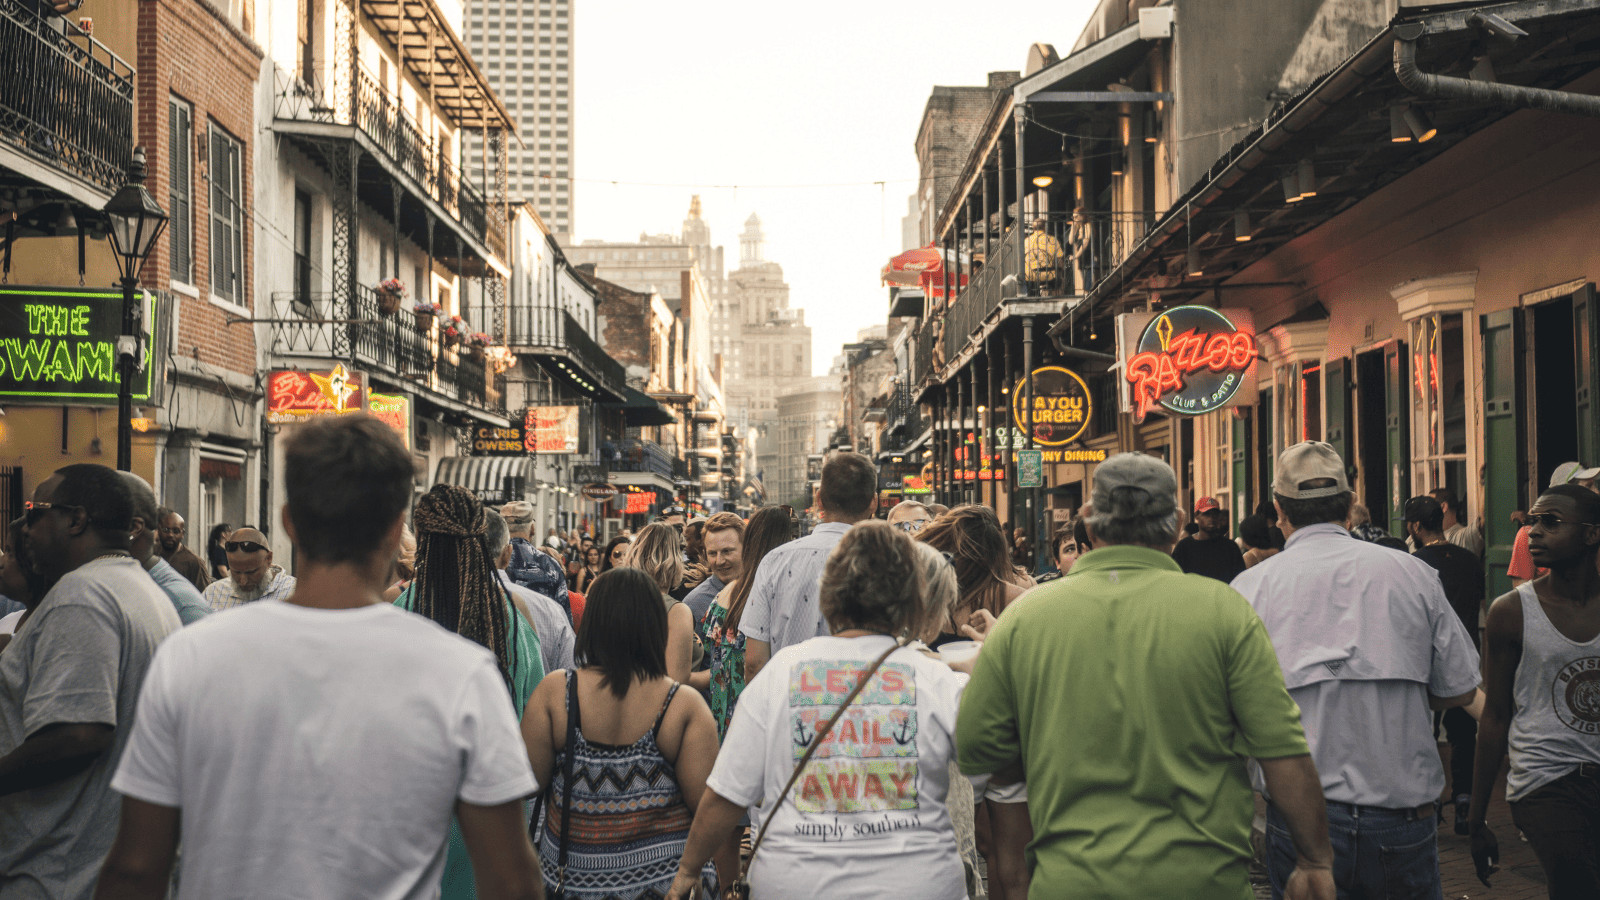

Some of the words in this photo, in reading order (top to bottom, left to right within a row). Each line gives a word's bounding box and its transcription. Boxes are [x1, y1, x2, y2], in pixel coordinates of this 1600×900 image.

[25, 304, 91, 336] THE
[0, 337, 150, 384] WAM
[1126, 326, 1258, 420] RAZZOO
[1172, 395, 1195, 408] CLUB
[1201, 396, 1209, 407] &
[1211, 373, 1236, 403] PATIO
[475, 440, 523, 452] OWENS
[1064, 450, 1106, 462] DINING
[477, 490, 502, 501] OWE
[814, 719, 894, 745] SAIL
[801, 772, 913, 801] AWAY
[794, 817, 847, 842] simply
[853, 813, 921, 837] southern
